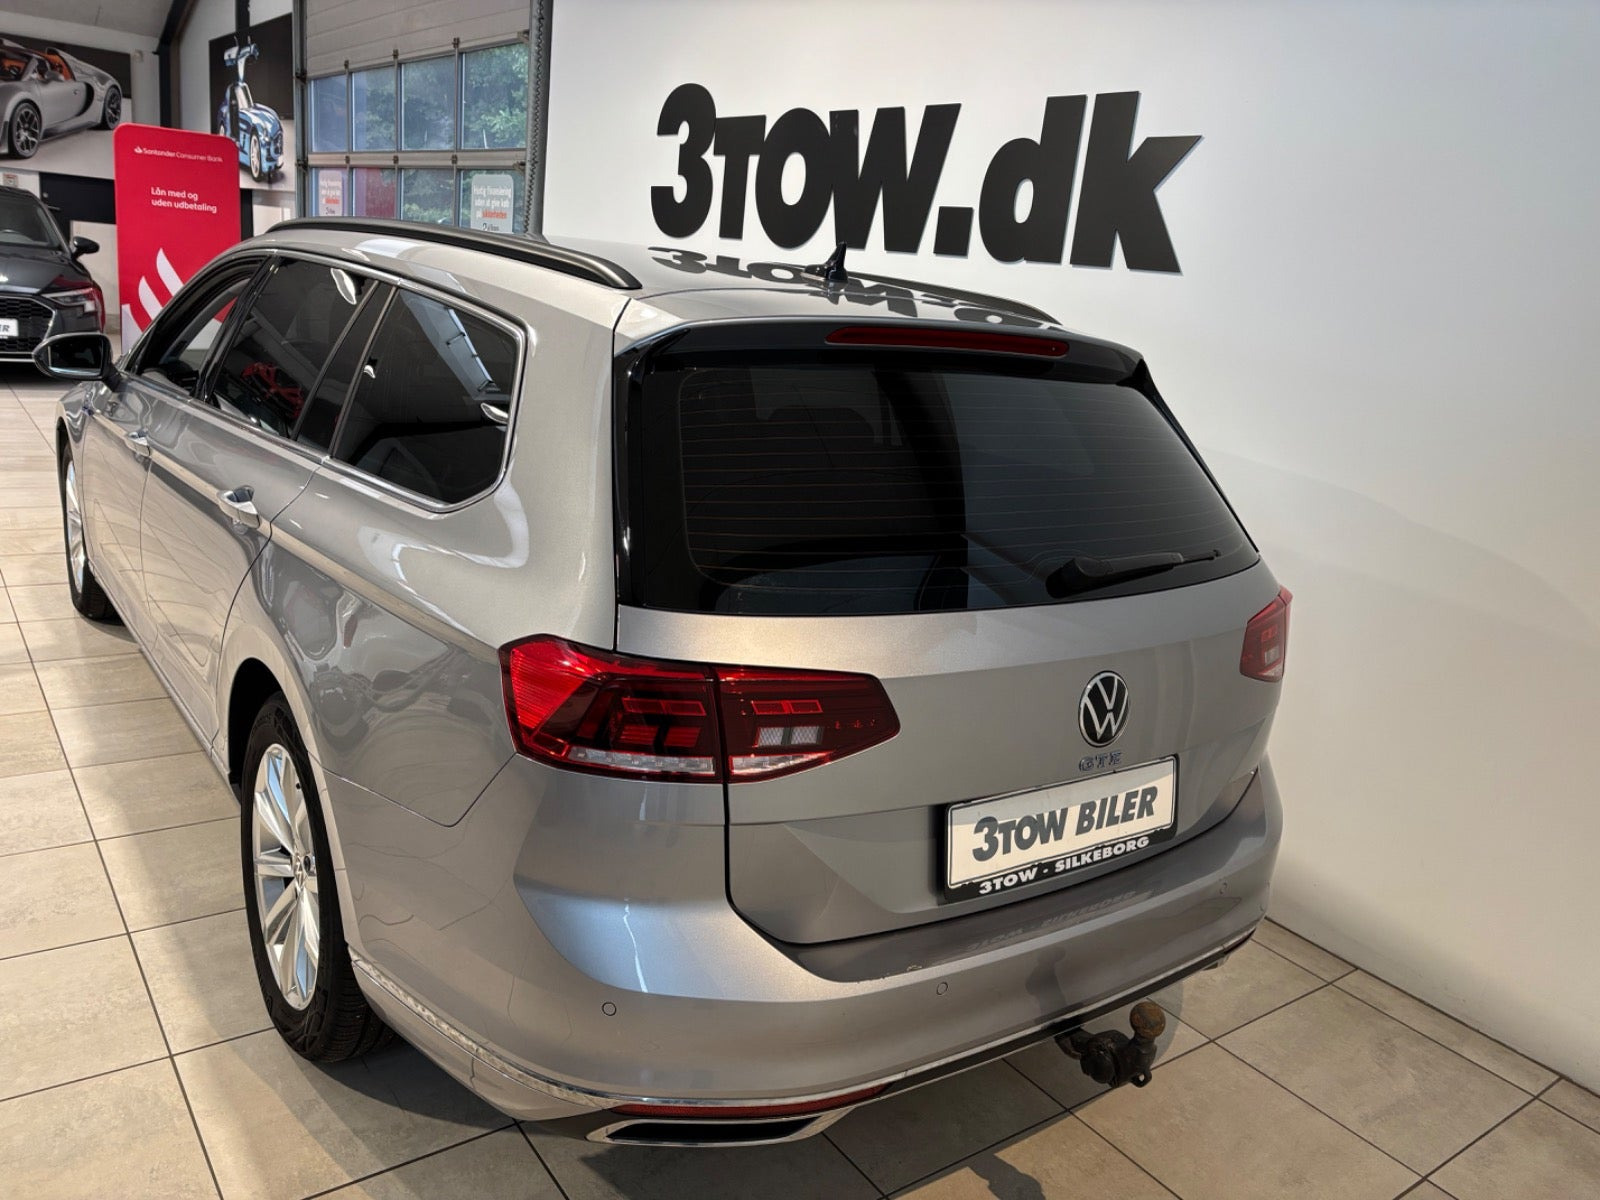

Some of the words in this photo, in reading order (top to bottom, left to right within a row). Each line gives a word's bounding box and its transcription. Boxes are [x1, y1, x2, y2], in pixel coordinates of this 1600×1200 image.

[142, 148, 176, 157] Santander
[175, 152, 207, 160] Consumer
[651, 83, 1203, 274] 3TOW.dk
[151, 187, 166, 196] Lån
[168, 190, 186, 198] med
[187, 193, 198, 201] og
[151, 199, 172, 207] uden
[174, 201, 217, 214] udbetaling
[1079, 752, 1121, 771] GTE
[972, 807, 1069, 862] 3TOW
[1075, 786, 1158, 836] BILER
[979, 867, 1038, 894] 3TOW
[1055, 836, 1150, 872] SILKEBORG
